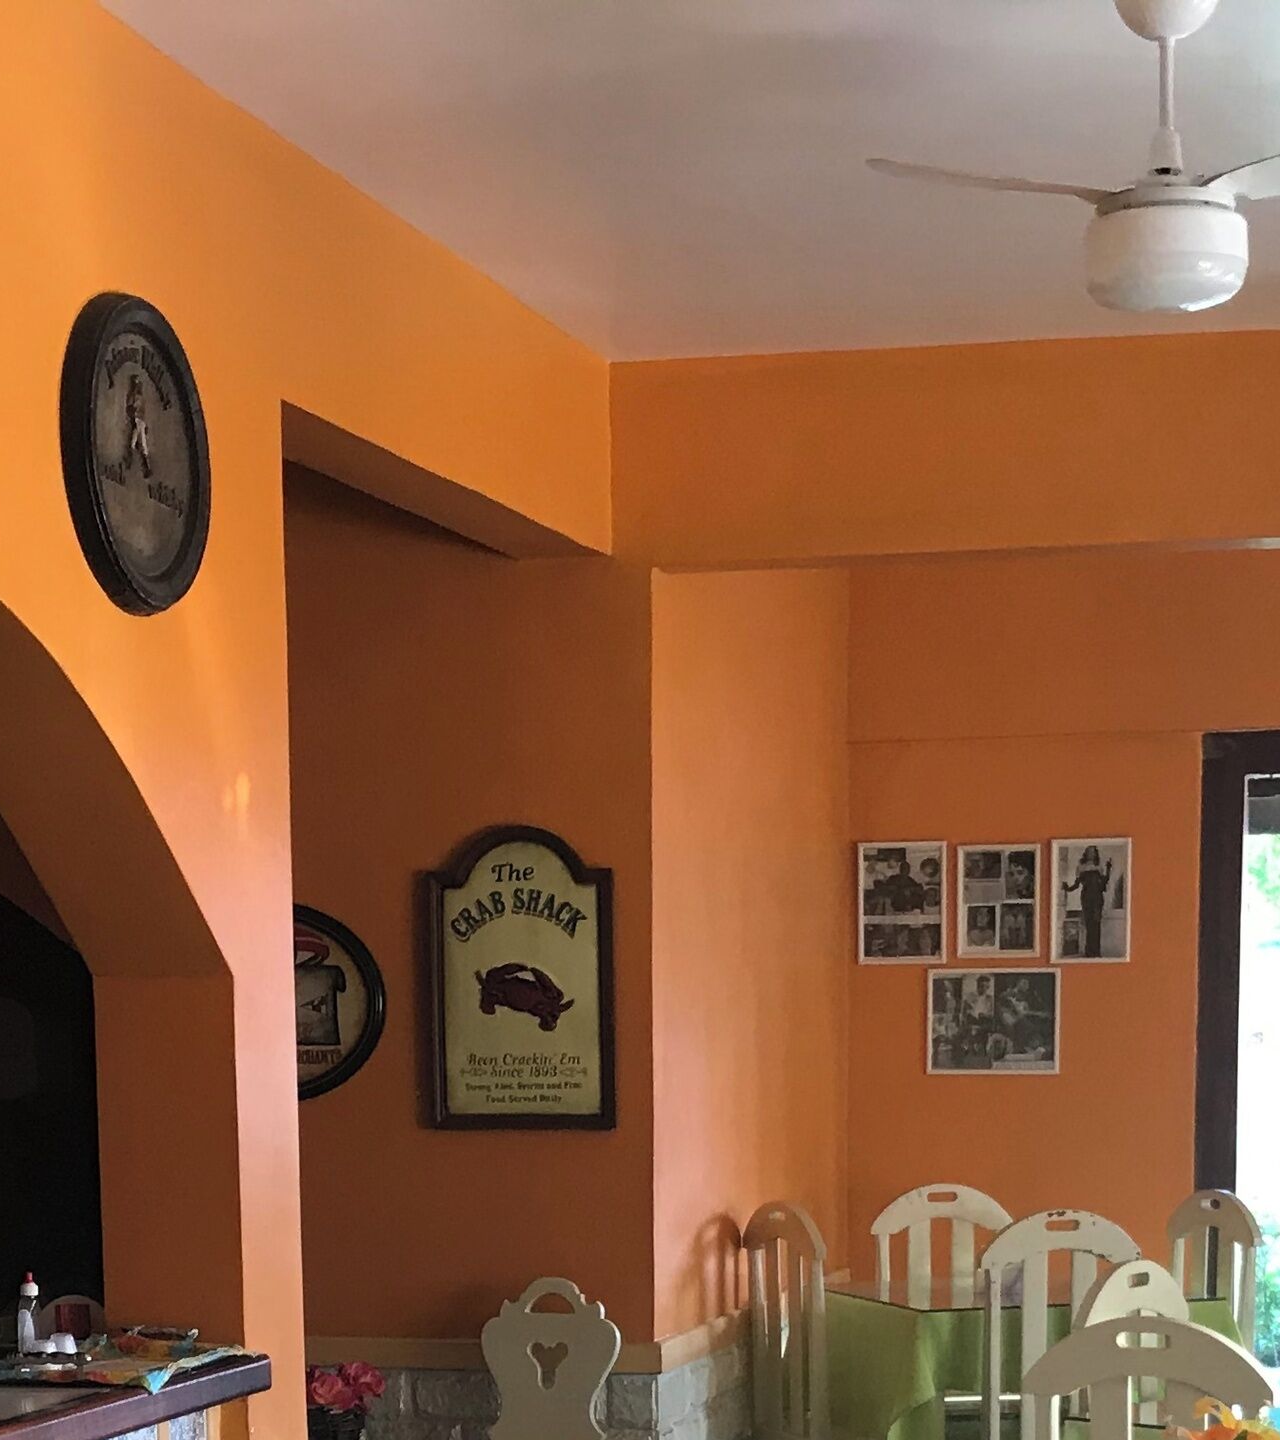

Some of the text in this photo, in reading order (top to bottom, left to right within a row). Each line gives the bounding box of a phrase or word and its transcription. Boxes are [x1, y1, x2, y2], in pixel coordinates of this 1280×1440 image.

[491, 863, 534, 883] The
[450, 887, 588, 943] CRAB SHACK
[490, 1065, 524, 1078] Since
